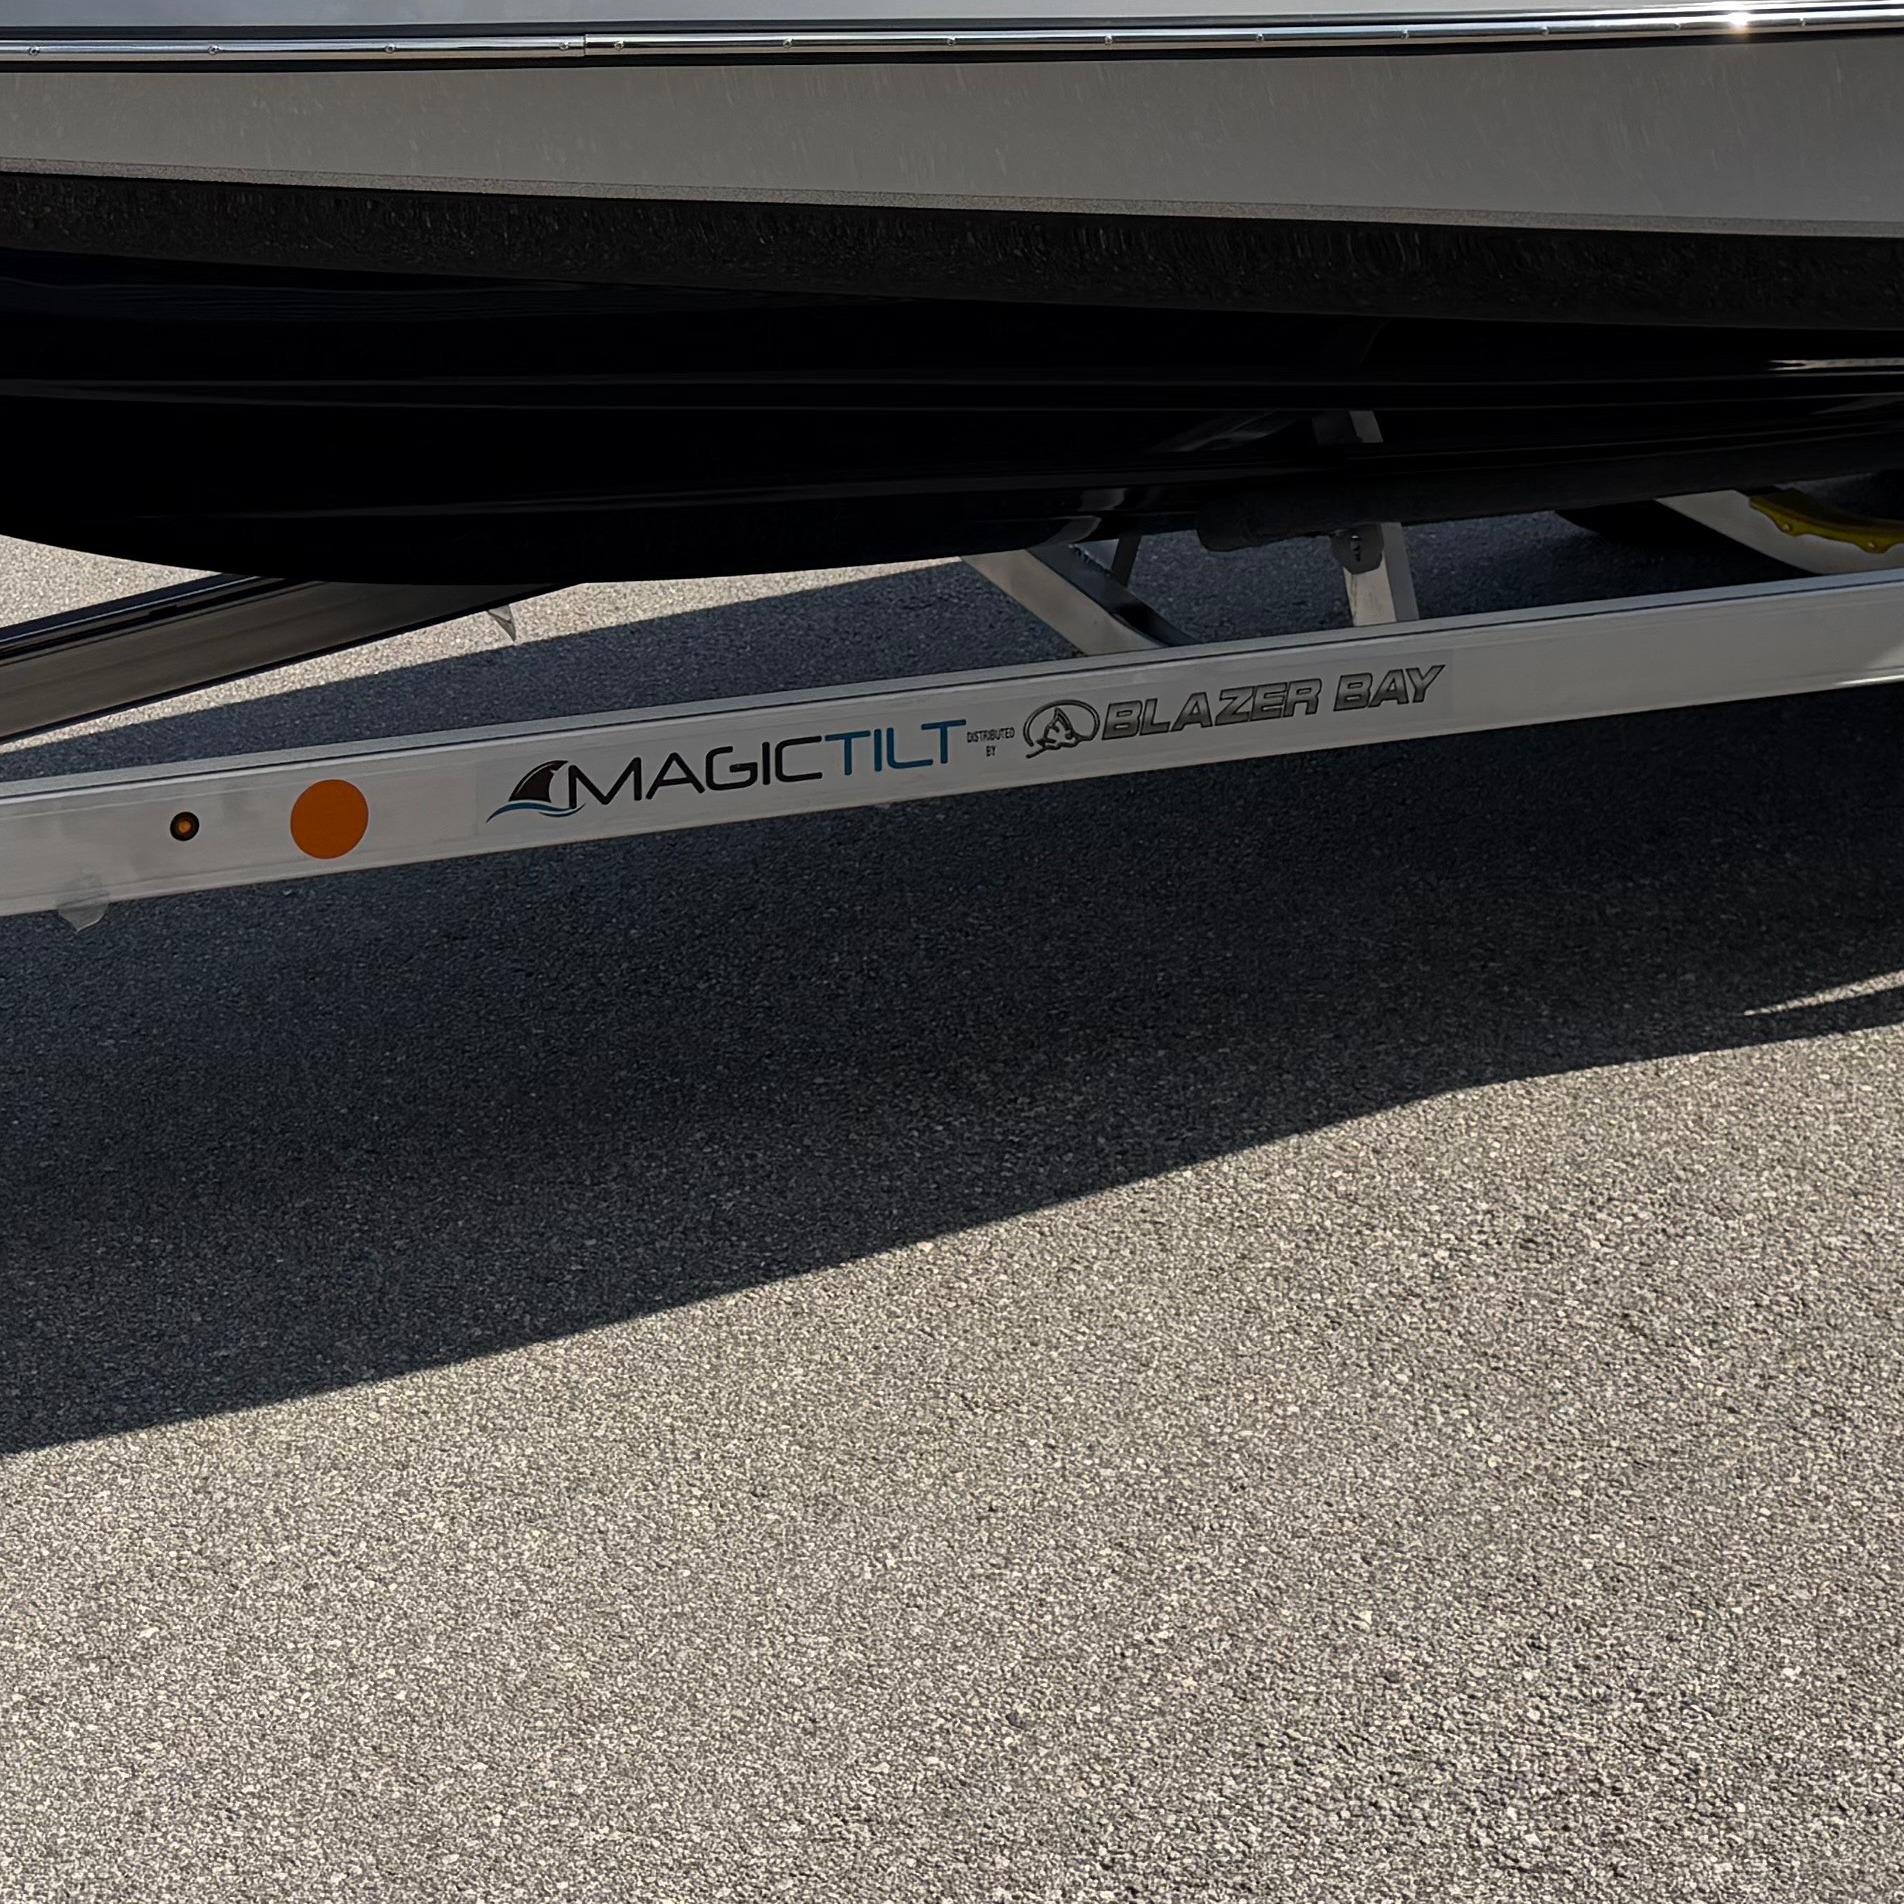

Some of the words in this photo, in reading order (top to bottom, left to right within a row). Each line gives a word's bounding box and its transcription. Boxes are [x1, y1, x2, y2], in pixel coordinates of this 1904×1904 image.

[1101, 677, 1323, 741] BLAZER
[1333, 663, 1446, 713] BAY
[567, 718, 968, 812] MAGICTILT
[985, 745, 996, 757] BY
